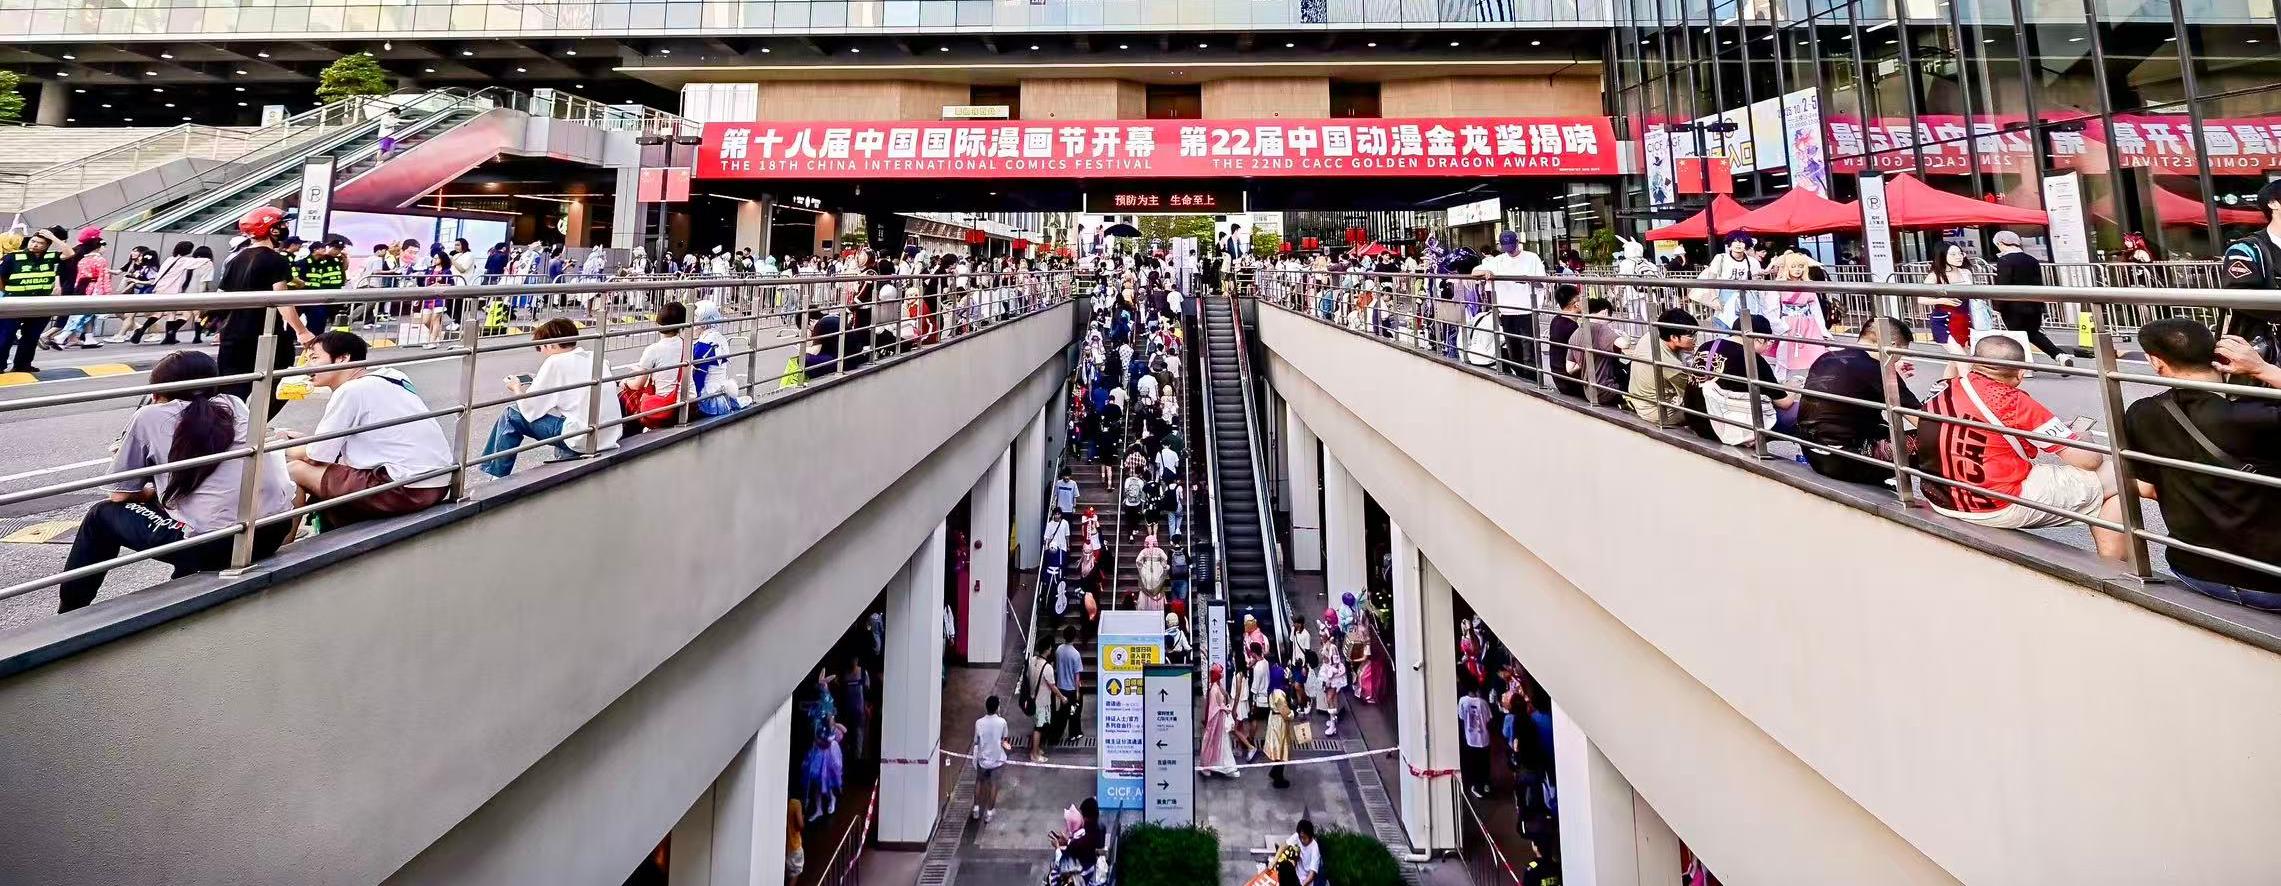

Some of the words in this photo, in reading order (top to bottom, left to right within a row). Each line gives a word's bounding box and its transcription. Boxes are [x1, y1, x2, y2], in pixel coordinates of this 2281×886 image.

[720, 126, 1156, 159] 第十八届中国国际漫画节开幕
[1179, 123, 1598, 157] 第22届中国动漫金龙奖揭晓
[721, 160, 750, 171] THE
[759, 160, 799, 171] 18TH
[807, 160, 856, 171] CHINA
[864, 159, 996, 171] INTERNATIONAL
[1005, 159, 1067, 170] COMICS
[1075, 159, 1153, 170] FESTIVAL
[1212, 158, 1244, 169] THE
[1252, 158, 1294, 169] 22ND
[1303, 158, 1343, 168] CACC
[1352, 157, 1418, 168] GOLDEN
[1427, 157, 1495, 168] DRAGON
[1503, 156, 1561, 168] AWARD
[1114, 194, 1160, 207] 预防为主
[1170, 194, 1215, 207] 生命至上
[20, 277, 50, 285] ANBAO
[1107, 786, 1131, 797] CICF
